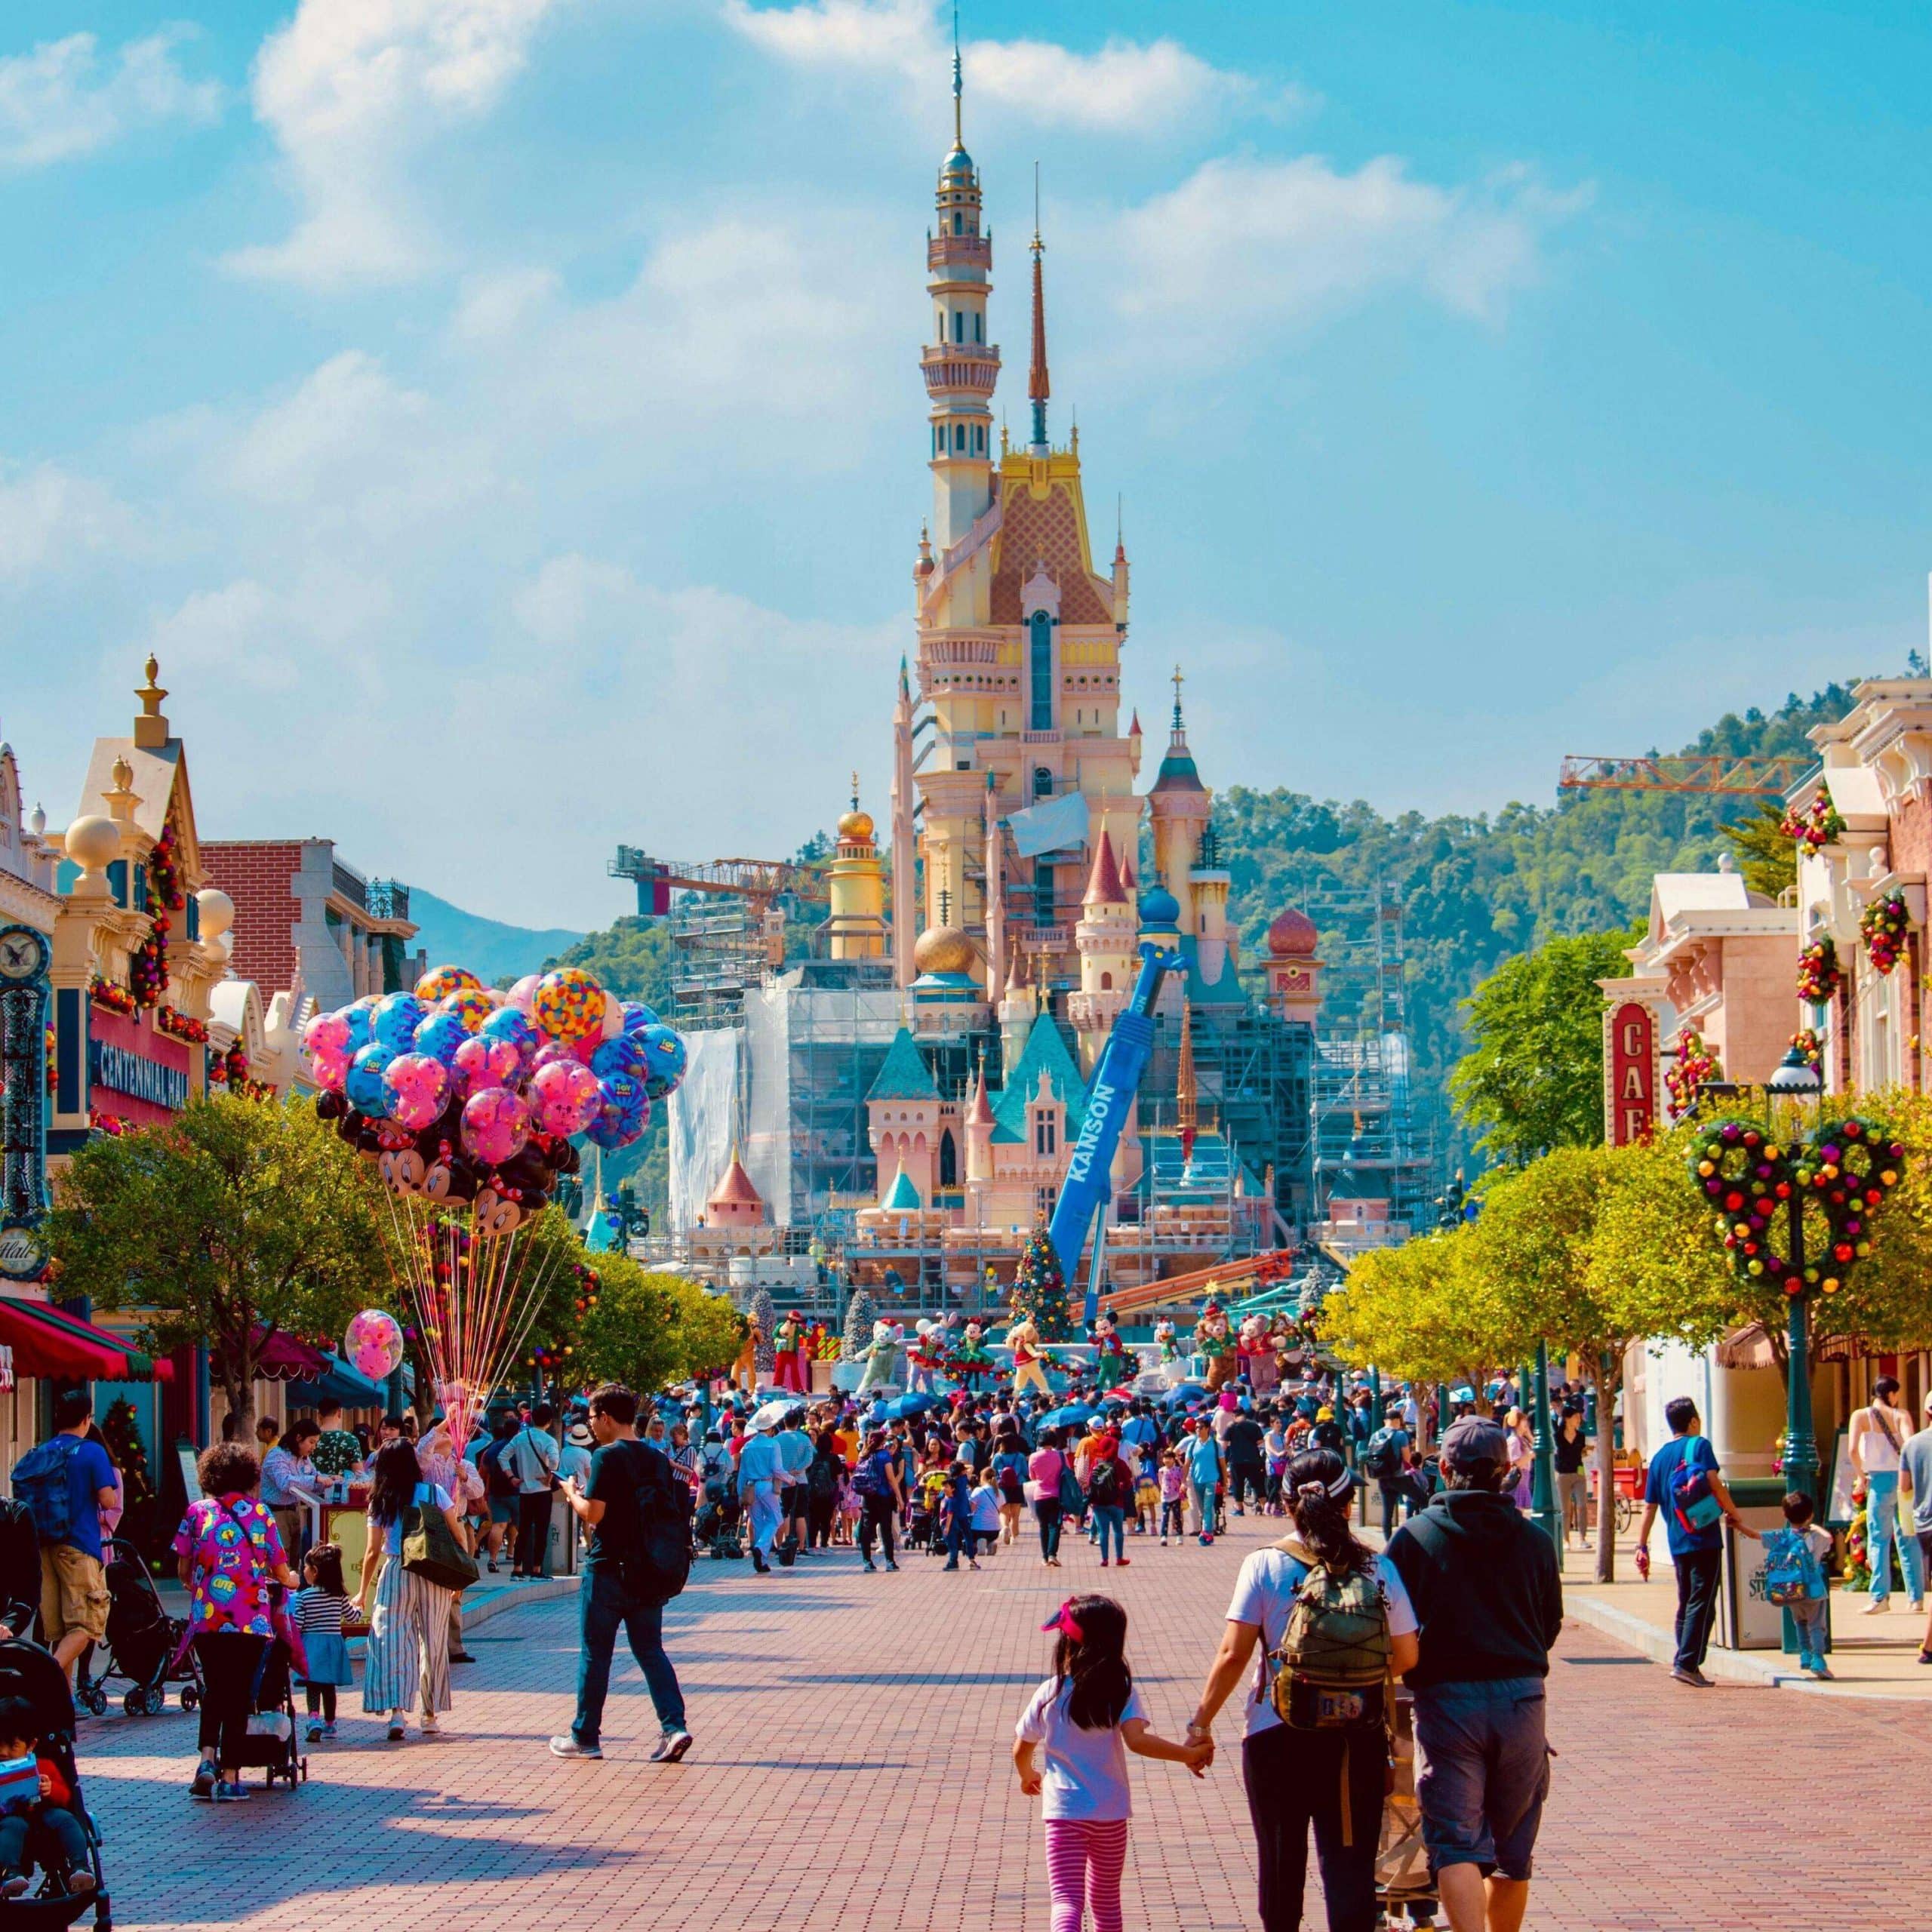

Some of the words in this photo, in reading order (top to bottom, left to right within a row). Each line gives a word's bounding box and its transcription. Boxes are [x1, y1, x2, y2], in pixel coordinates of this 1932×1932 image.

[101, 1043, 167, 1107] CENTENNIAL
[1623, 1023, 1645, 1143] CAF
[1068, 1083, 1115, 1183] KANSON
[213, 1578, 235, 1592] CUTE
